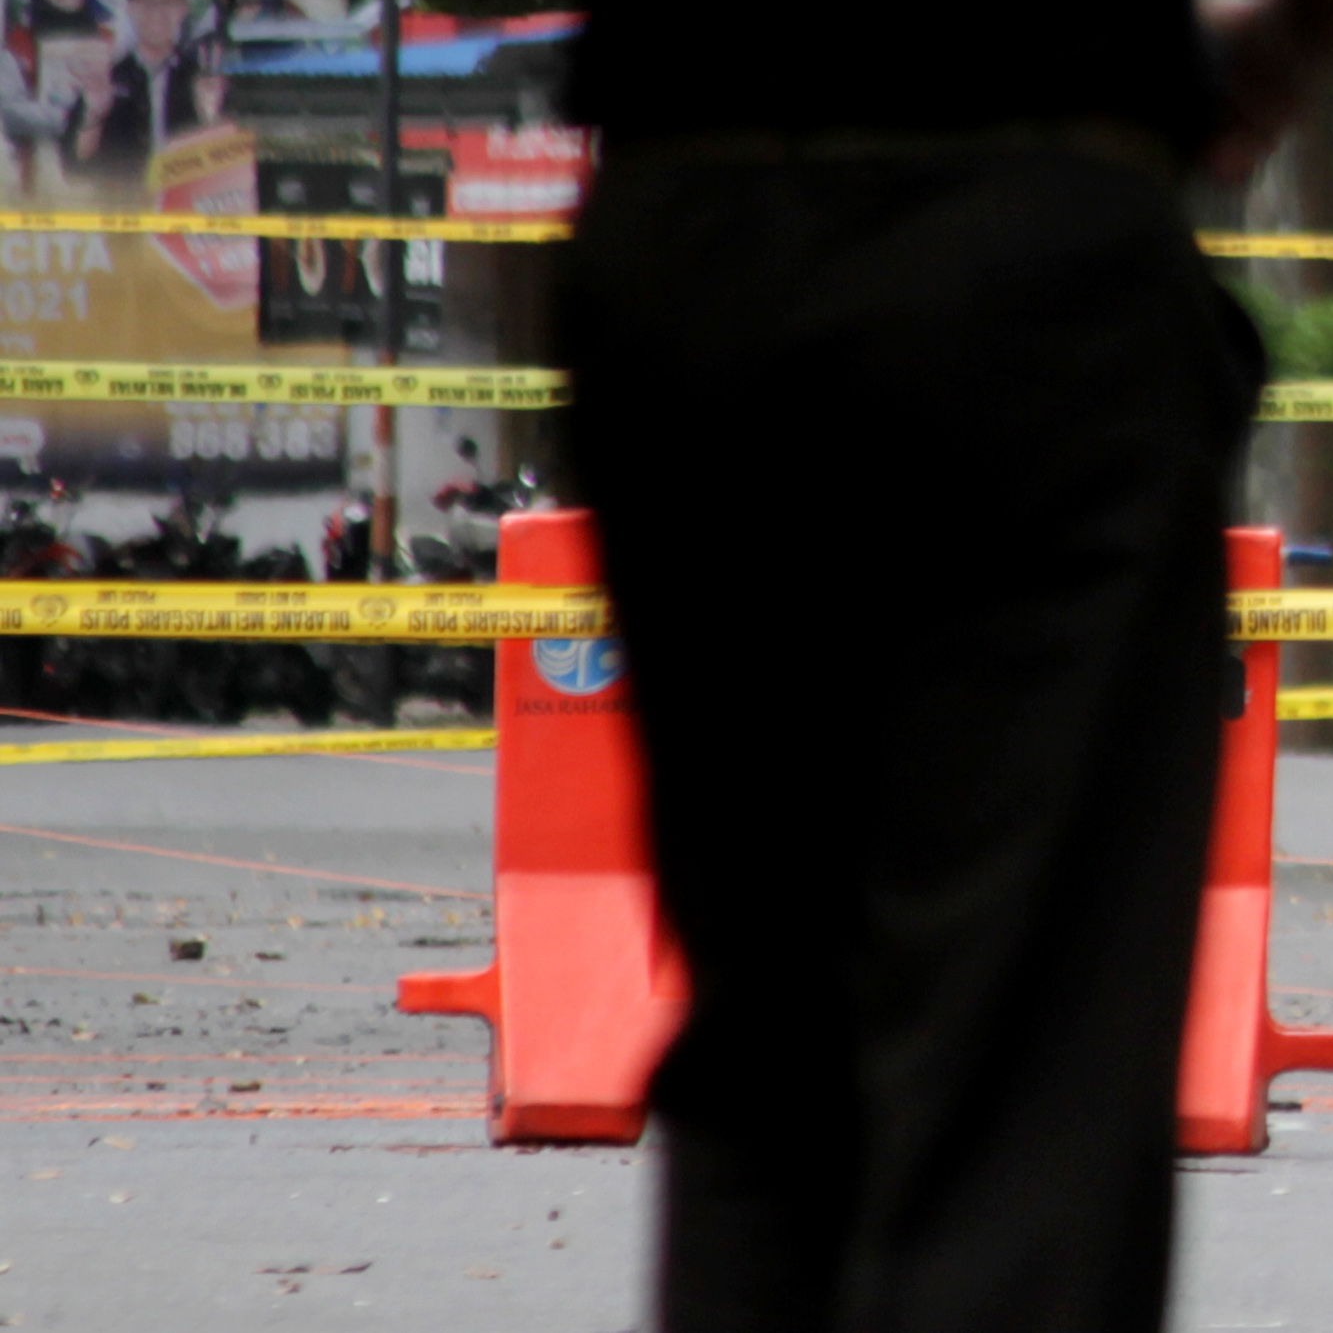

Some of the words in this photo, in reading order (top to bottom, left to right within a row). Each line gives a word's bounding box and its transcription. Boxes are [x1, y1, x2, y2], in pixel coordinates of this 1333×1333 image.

[0, 278, 88, 322] 021
[80, 609, 129, 631] POLISI
[270, 610, 350, 632] DILARANG
[408, 610, 457, 632] POLISI
[1249, 609, 1327, 632] DILARANG
